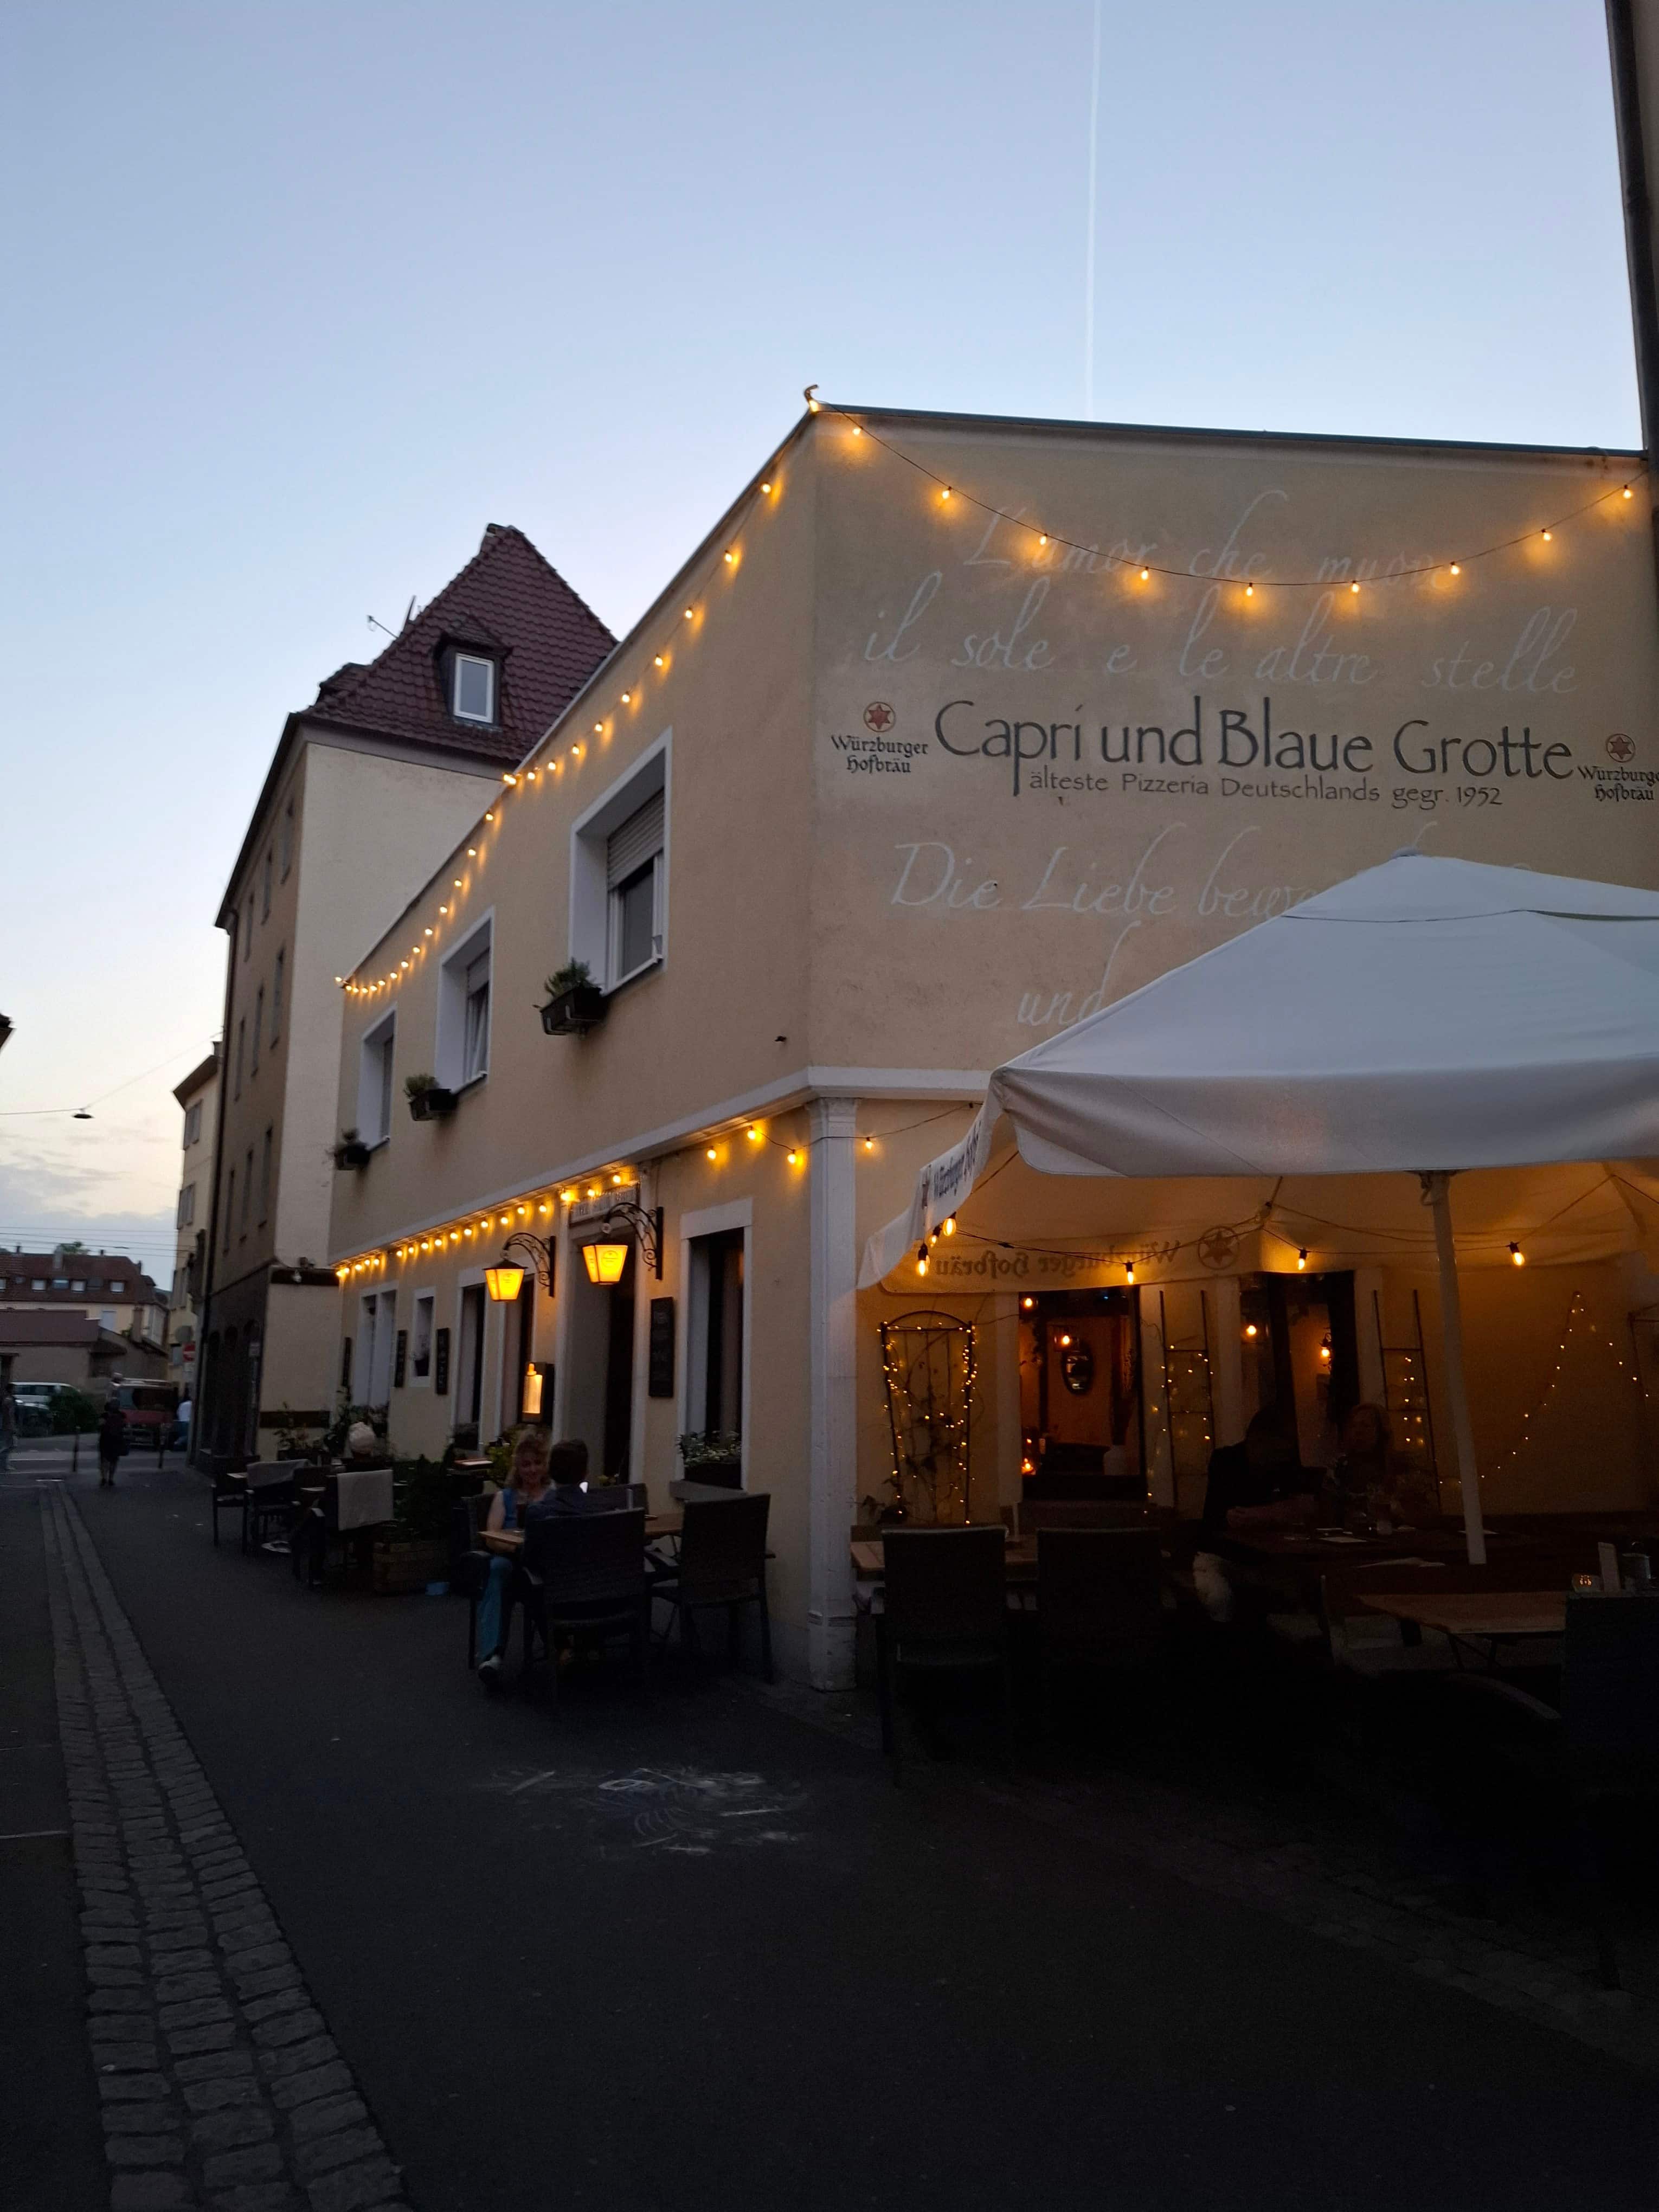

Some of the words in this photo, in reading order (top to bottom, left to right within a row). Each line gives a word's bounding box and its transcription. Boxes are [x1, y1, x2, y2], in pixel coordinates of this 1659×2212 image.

[1188, 489, 1289, 578] che
[863, 571, 943, 662] il
[952, 576, 1056, 670] sole
[1107, 643, 1137, 674] e
[1179, 584, 1229, 679] le
[1255, 592, 1377, 685] altre
[1422, 606, 1578, 695] stelle
[831, 734, 929, 755] Würzburger
[846, 755, 911, 774] Hofbräu
[934, 700, 1084, 796] Capri
[1099, 696, 1203, 766] und
[1218, 696, 1374, 773] Blaue
[1393, 719, 1575, 779] Grotte
[1028, 764, 1110, 791] älteste
[1121, 773, 1210, 795] Pizzeria
[1220, 775, 1380, 801] Deutschlands
[1391, 785, 1450, 810] gegr.
[1456, 786, 1504, 807] 1952
[890, 841, 1003, 910] Die
[1022, 821, 1187, 916] Liebe
[1017, 920, 1141, 1026] und
